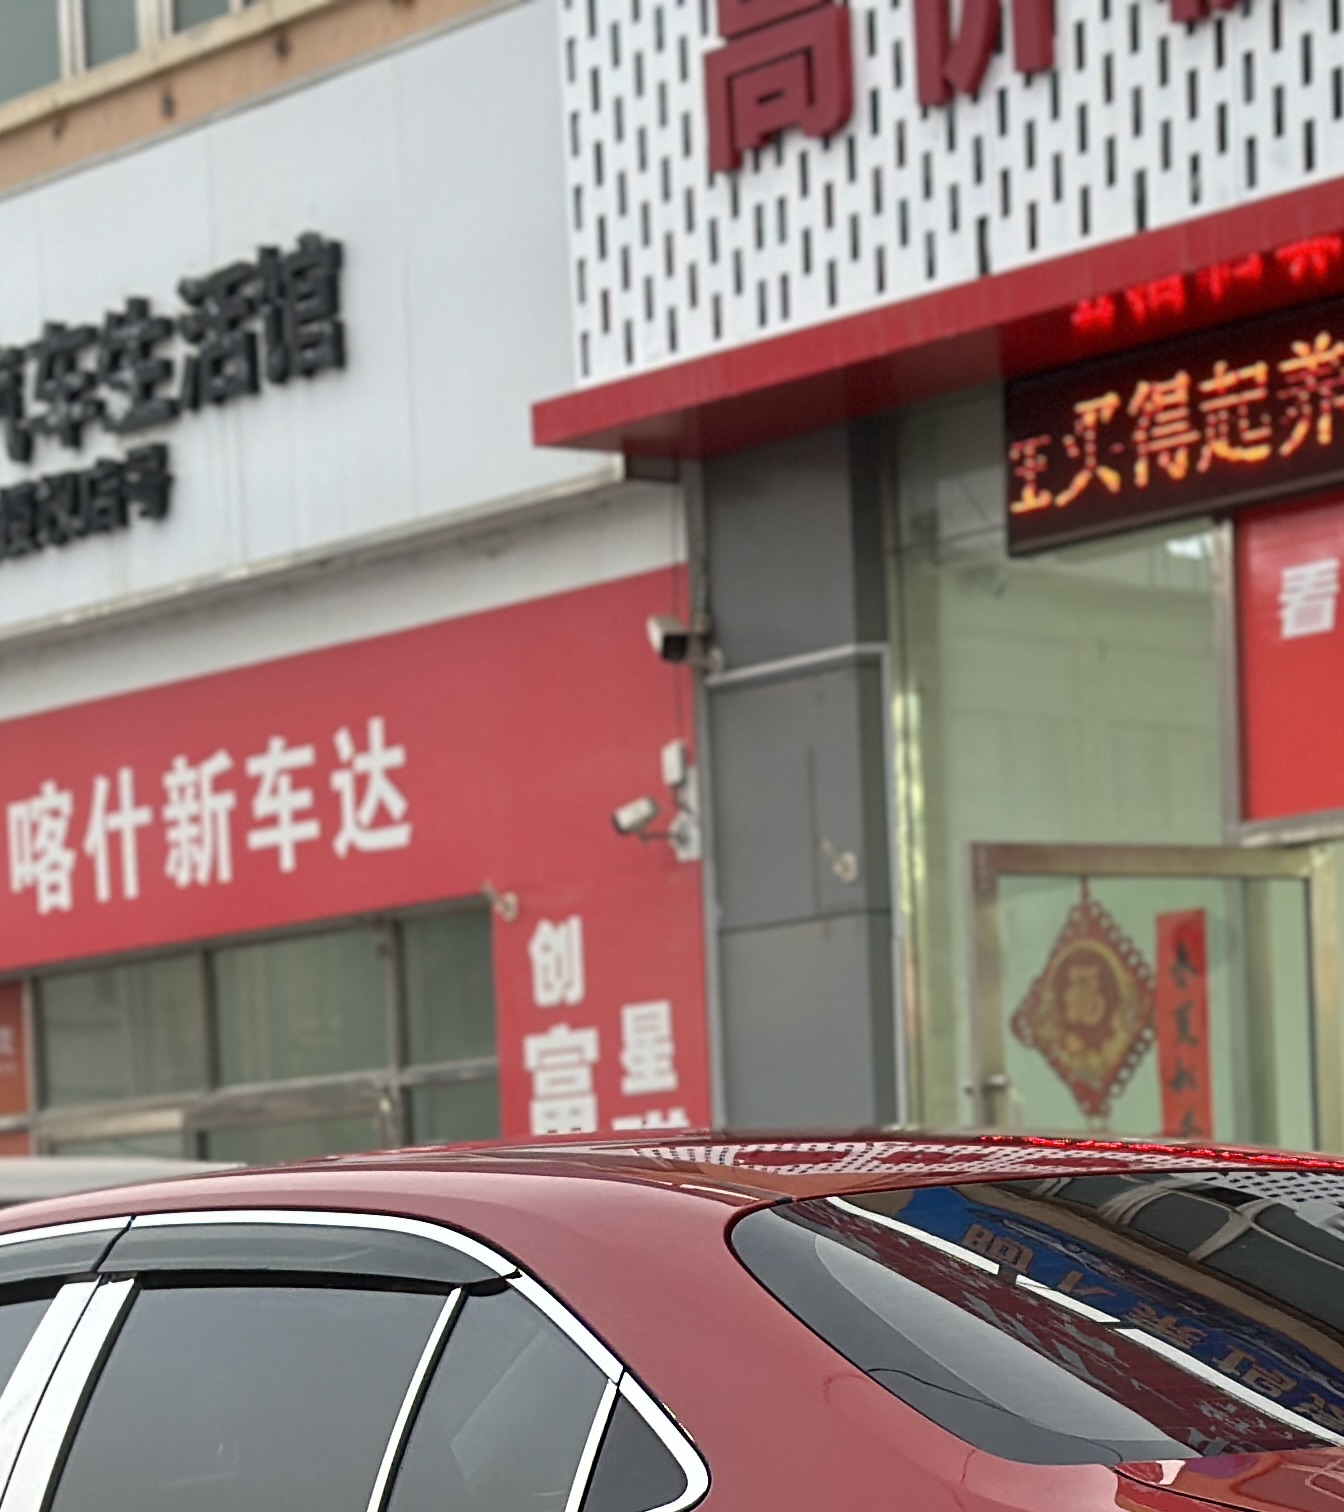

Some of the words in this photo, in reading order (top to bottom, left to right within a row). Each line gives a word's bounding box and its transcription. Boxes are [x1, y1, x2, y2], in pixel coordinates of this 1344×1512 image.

[8, 717, 412, 915] 喀什新车达
[613, 999, 690, 1131] 星
